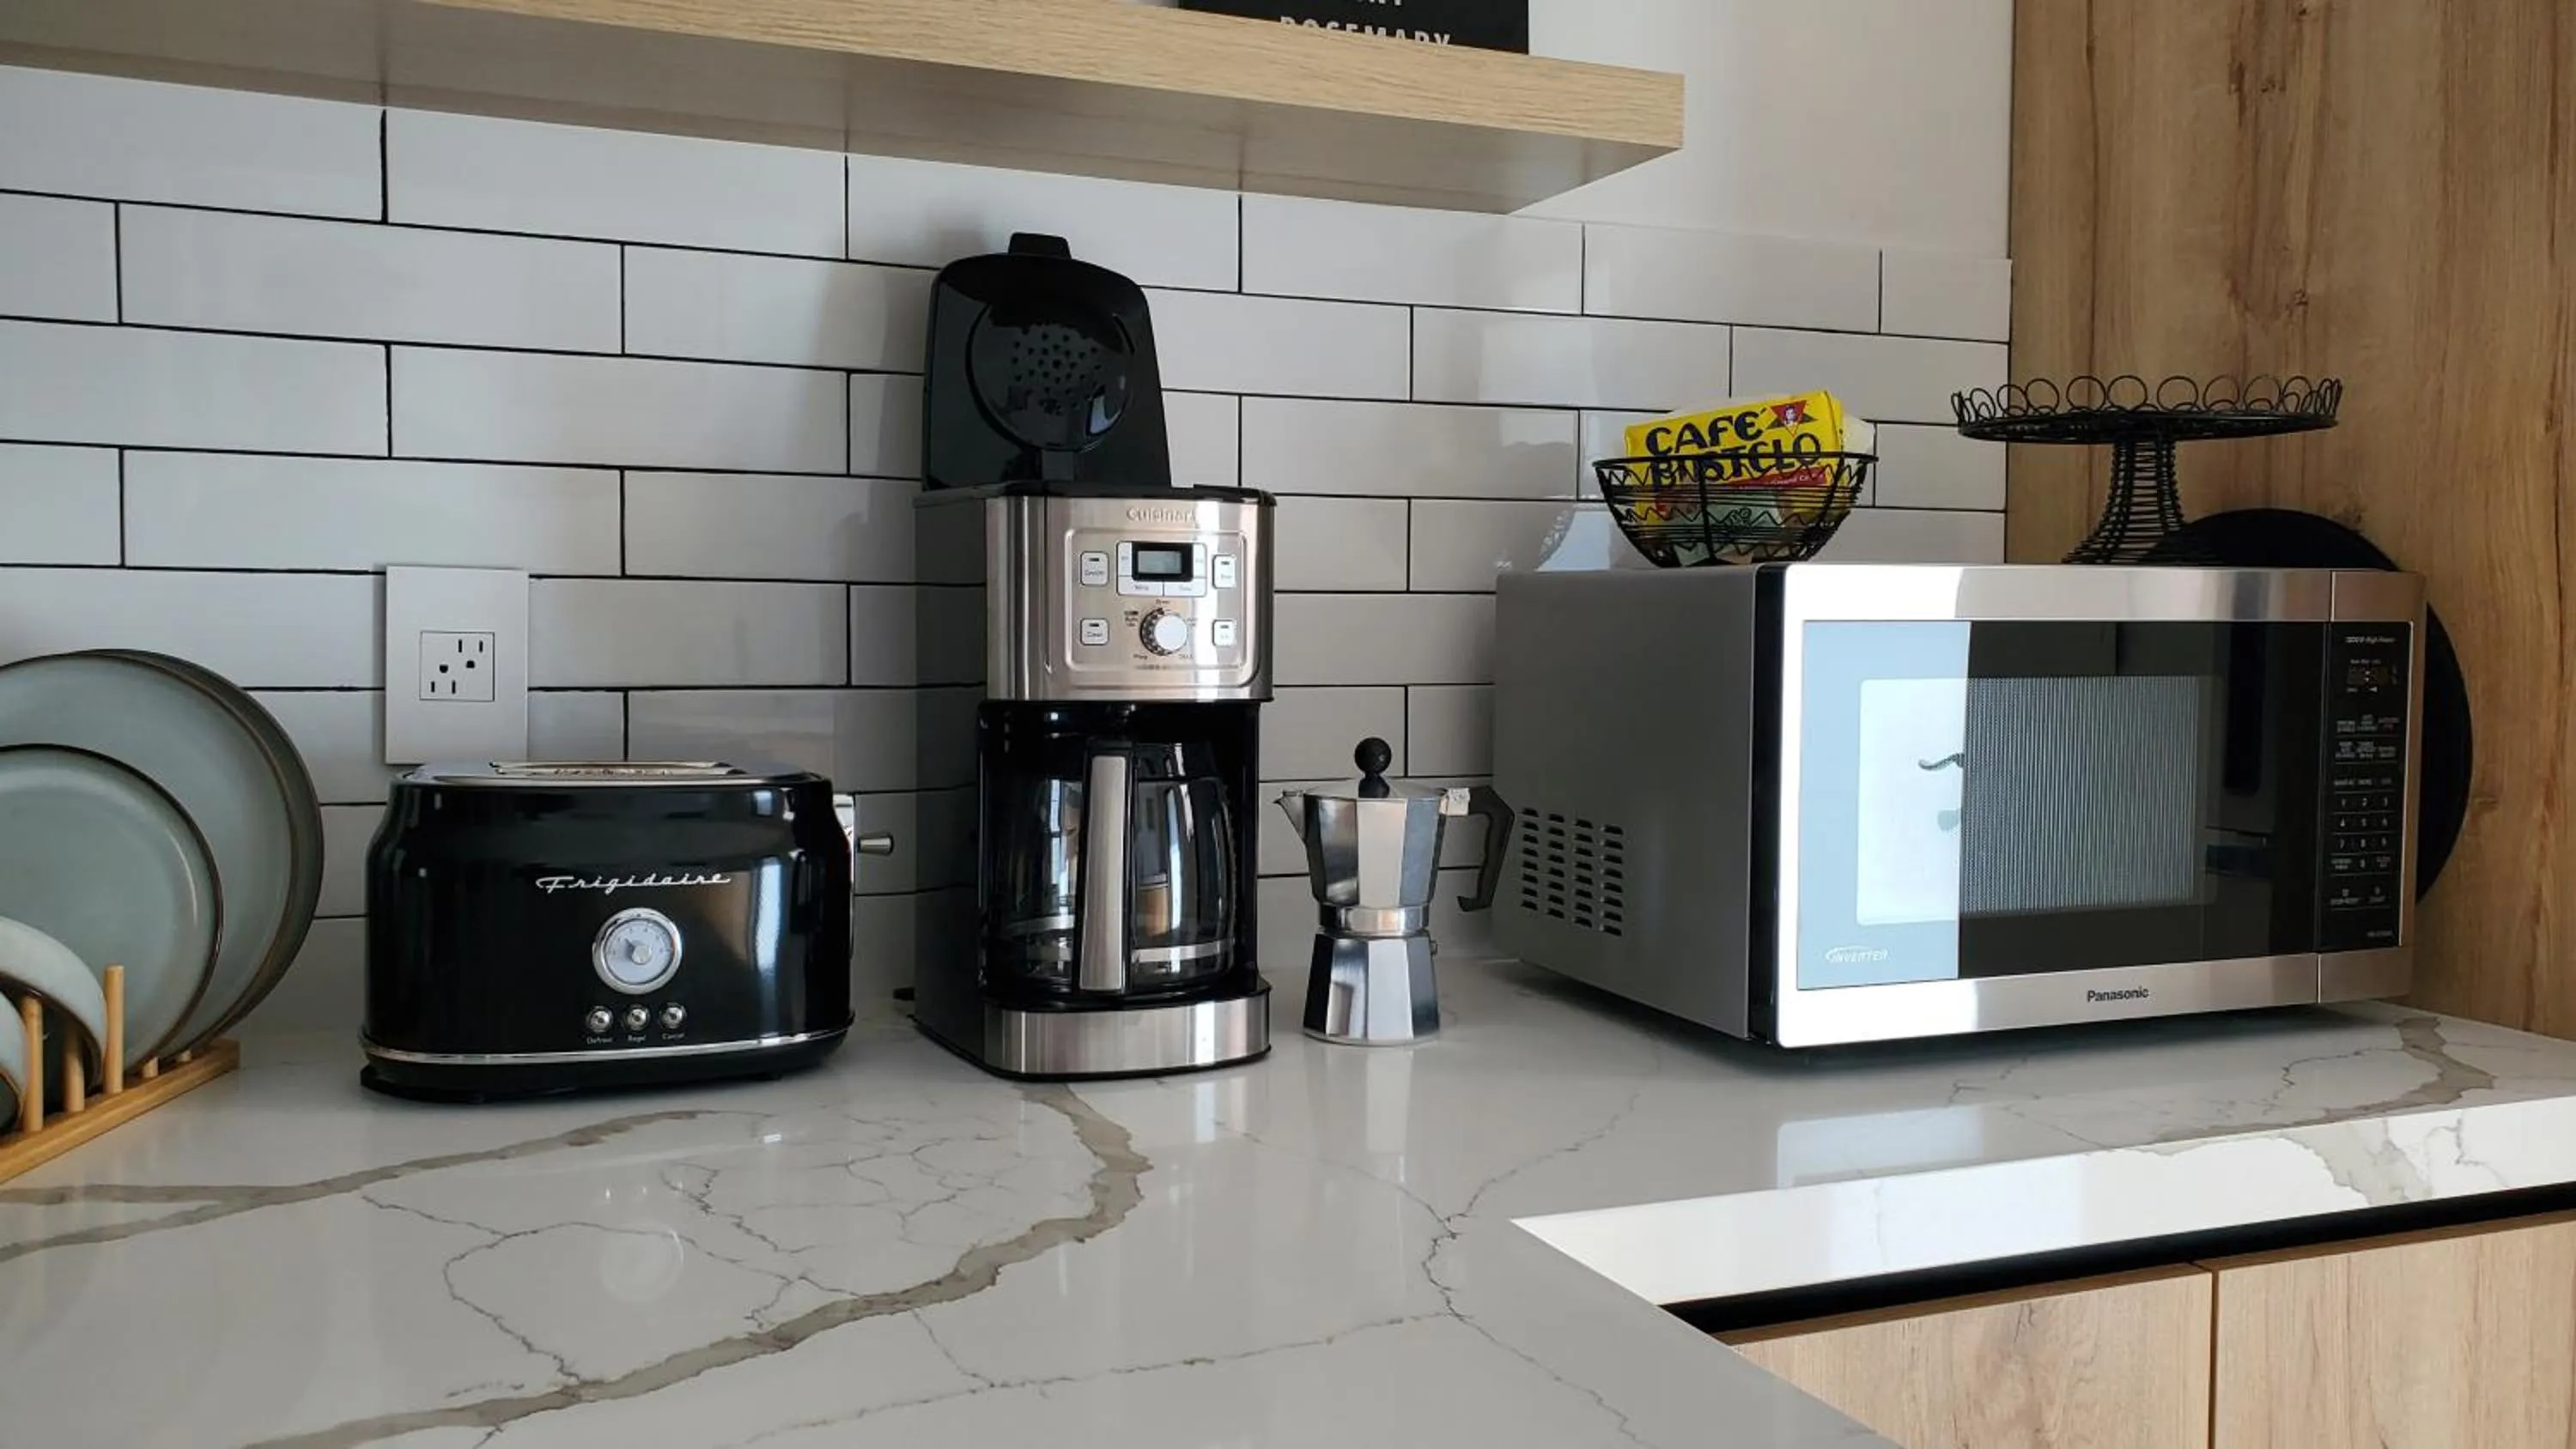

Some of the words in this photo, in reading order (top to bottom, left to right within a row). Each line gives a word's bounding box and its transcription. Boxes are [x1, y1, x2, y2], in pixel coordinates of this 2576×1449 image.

[1646, 407, 1766, 455] CAFÉ
[1126, 507, 1197, 523] Cuisinar
[536, 873, 731, 894] Frigidaire
[2087, 985, 2149, 1003] Panasonic
